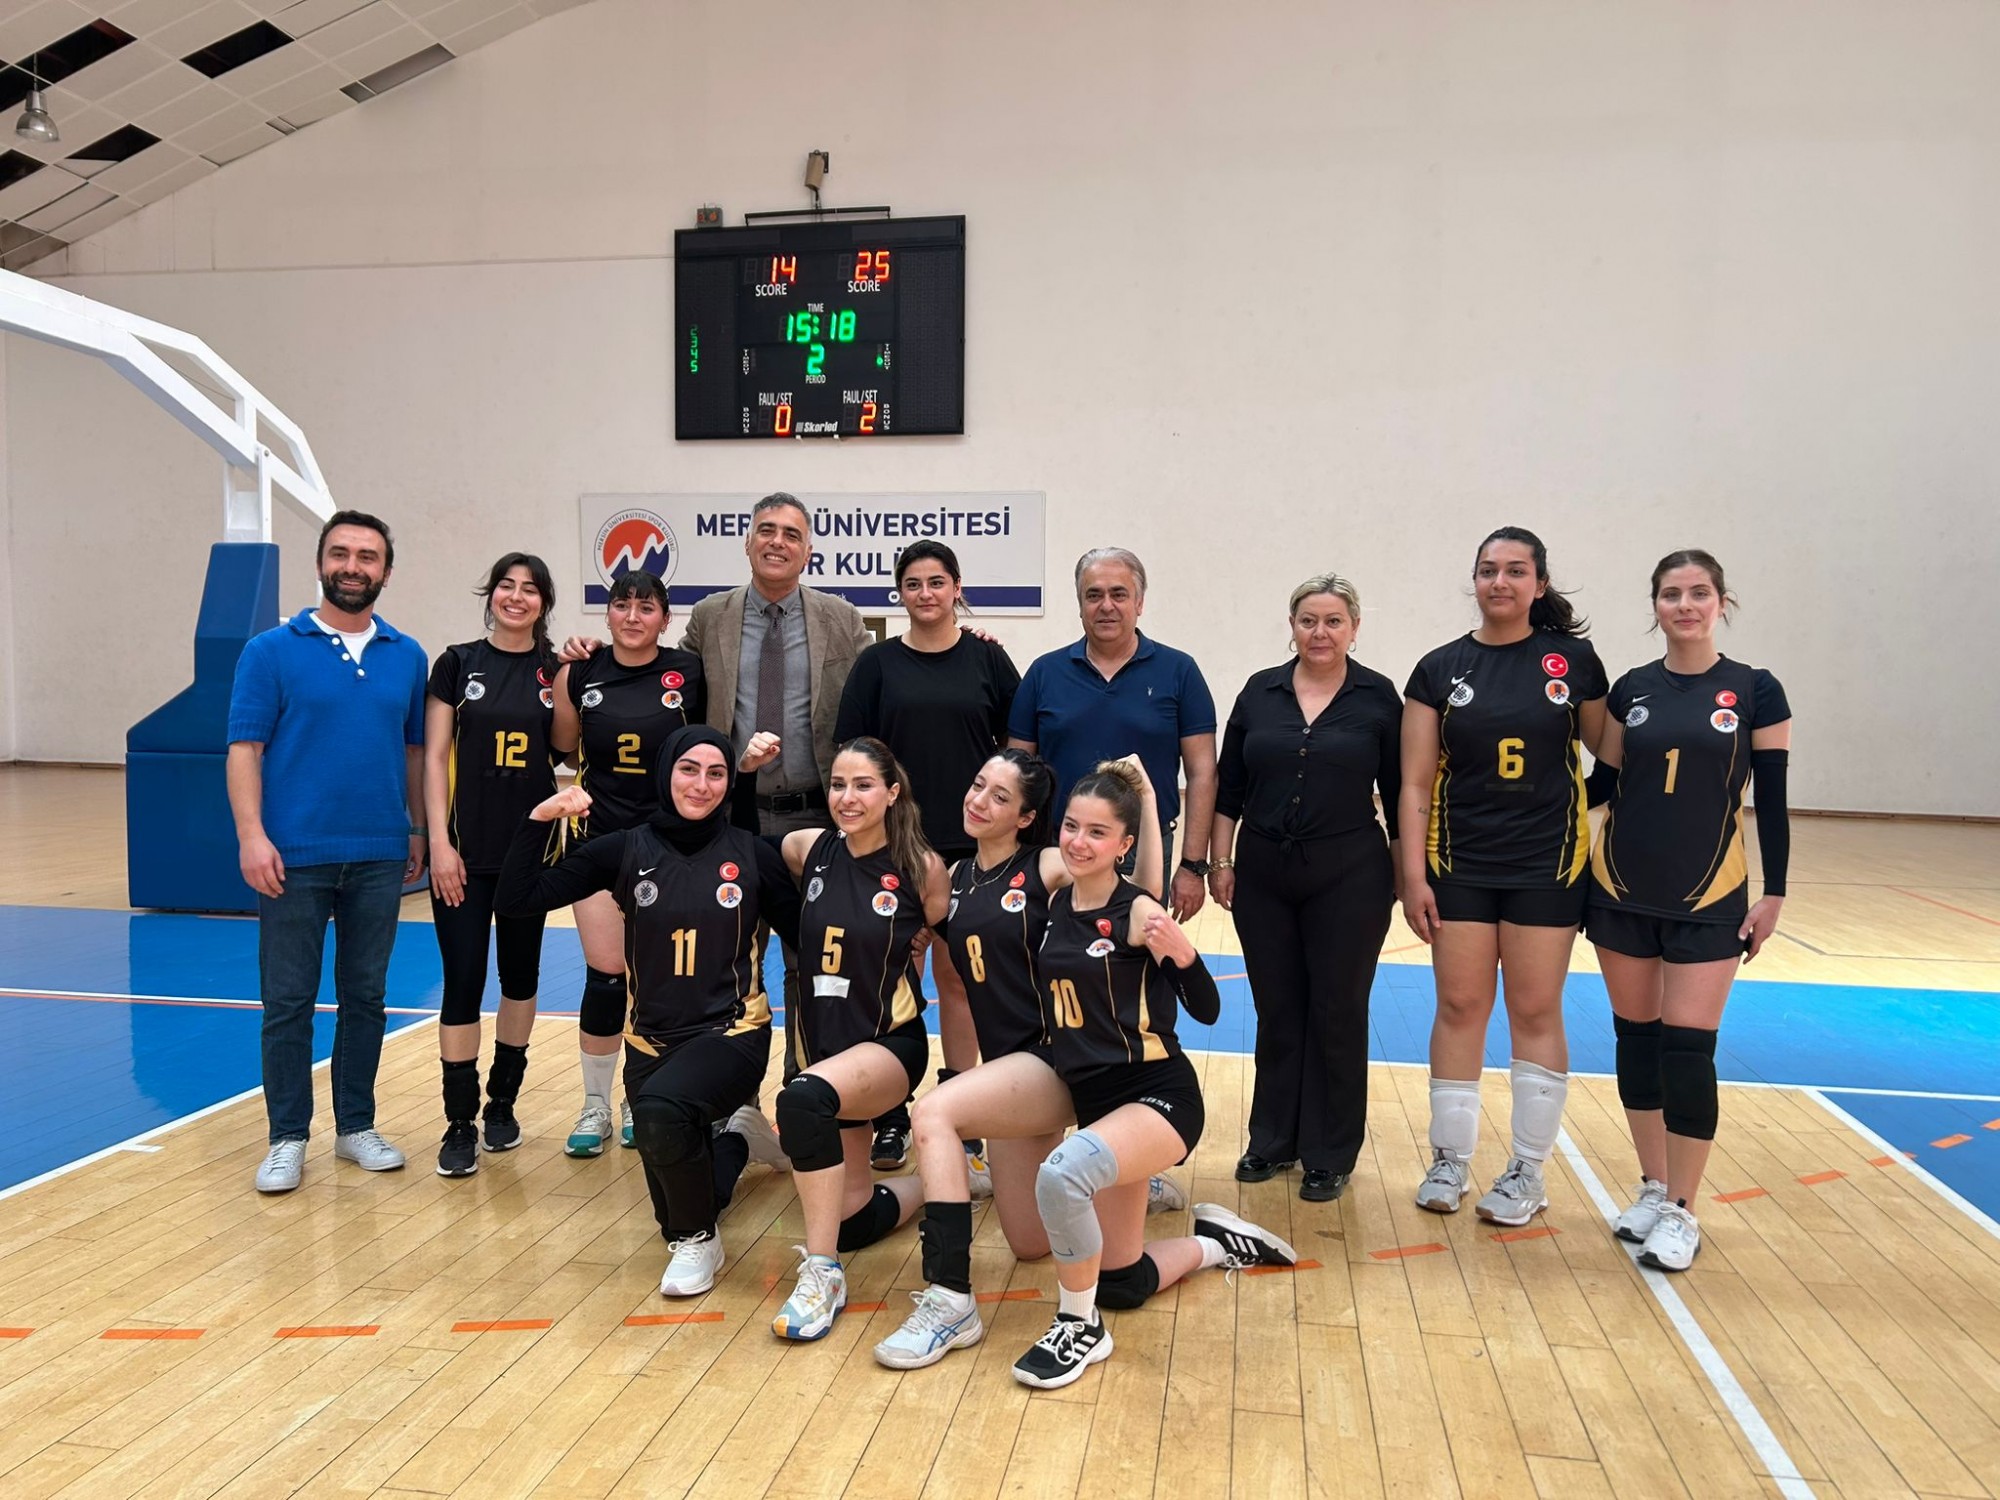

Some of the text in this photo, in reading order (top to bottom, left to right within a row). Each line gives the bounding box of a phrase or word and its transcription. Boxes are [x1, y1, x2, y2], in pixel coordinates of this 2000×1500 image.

[771, 255, 797, 283] 14
[854, 250, 890, 280] 25
[755, 283, 788, 297] SCORE
[847, 279, 881, 293] SCORE
[807, 303, 824, 313] TIME
[786, 311, 856, 342] 15:18
[807, 344, 825, 375] 2
[805, 374, 827, 384] PERIOD
[758, 392, 793, 406] FAUL/SET
[842, 389, 878, 403] FAUL/SET
[775, 405, 792, 433] 0
[860, 403, 877, 431] 2
[697, 506, 1010, 537] MER ÜNİVERSİTESİ
[495, 730, 529, 768] 12
[617, 733, 641, 764] 2
[1498, 738, 1525, 779] 6
[1664, 748, 1680, 794] 1
[671, 928, 697, 976] 11
[822, 926, 845, 974] 5
[965, 934, 986, 983] 8
[1050, 979, 1084, 1028] 10
